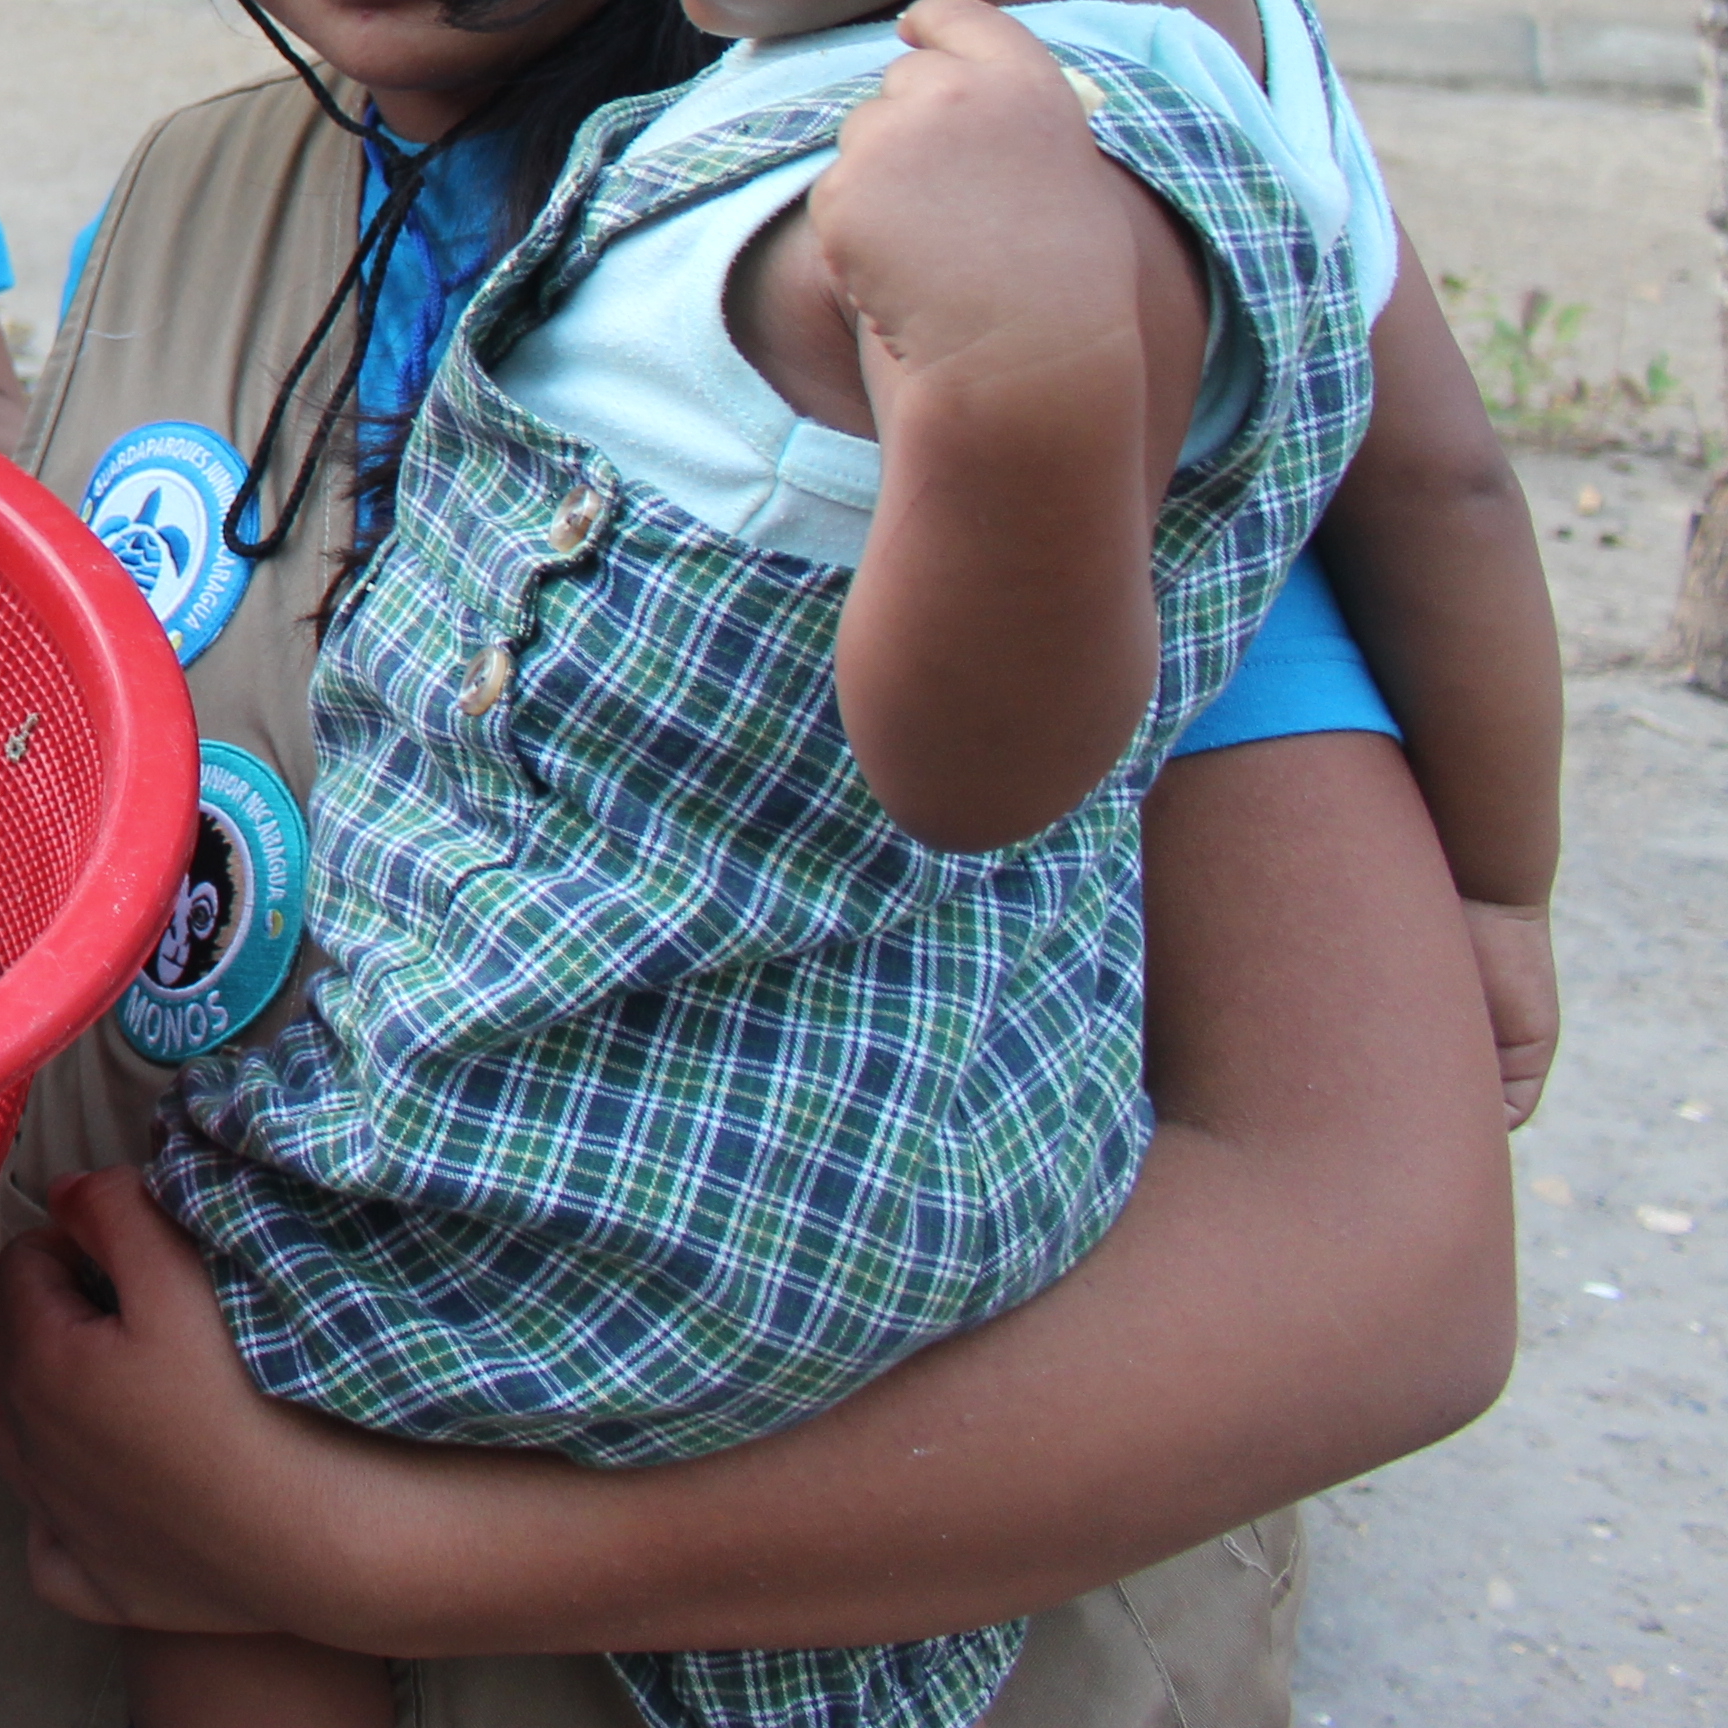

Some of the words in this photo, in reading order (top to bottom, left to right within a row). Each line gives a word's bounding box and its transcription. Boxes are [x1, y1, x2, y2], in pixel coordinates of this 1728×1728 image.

[94, 436, 213, 498] GUARDAPARQUES
[199, 762, 251, 804] UNIOR
[240, 790, 288, 904] NICARAGUA
[123, 984, 231, 1056] MONOS
